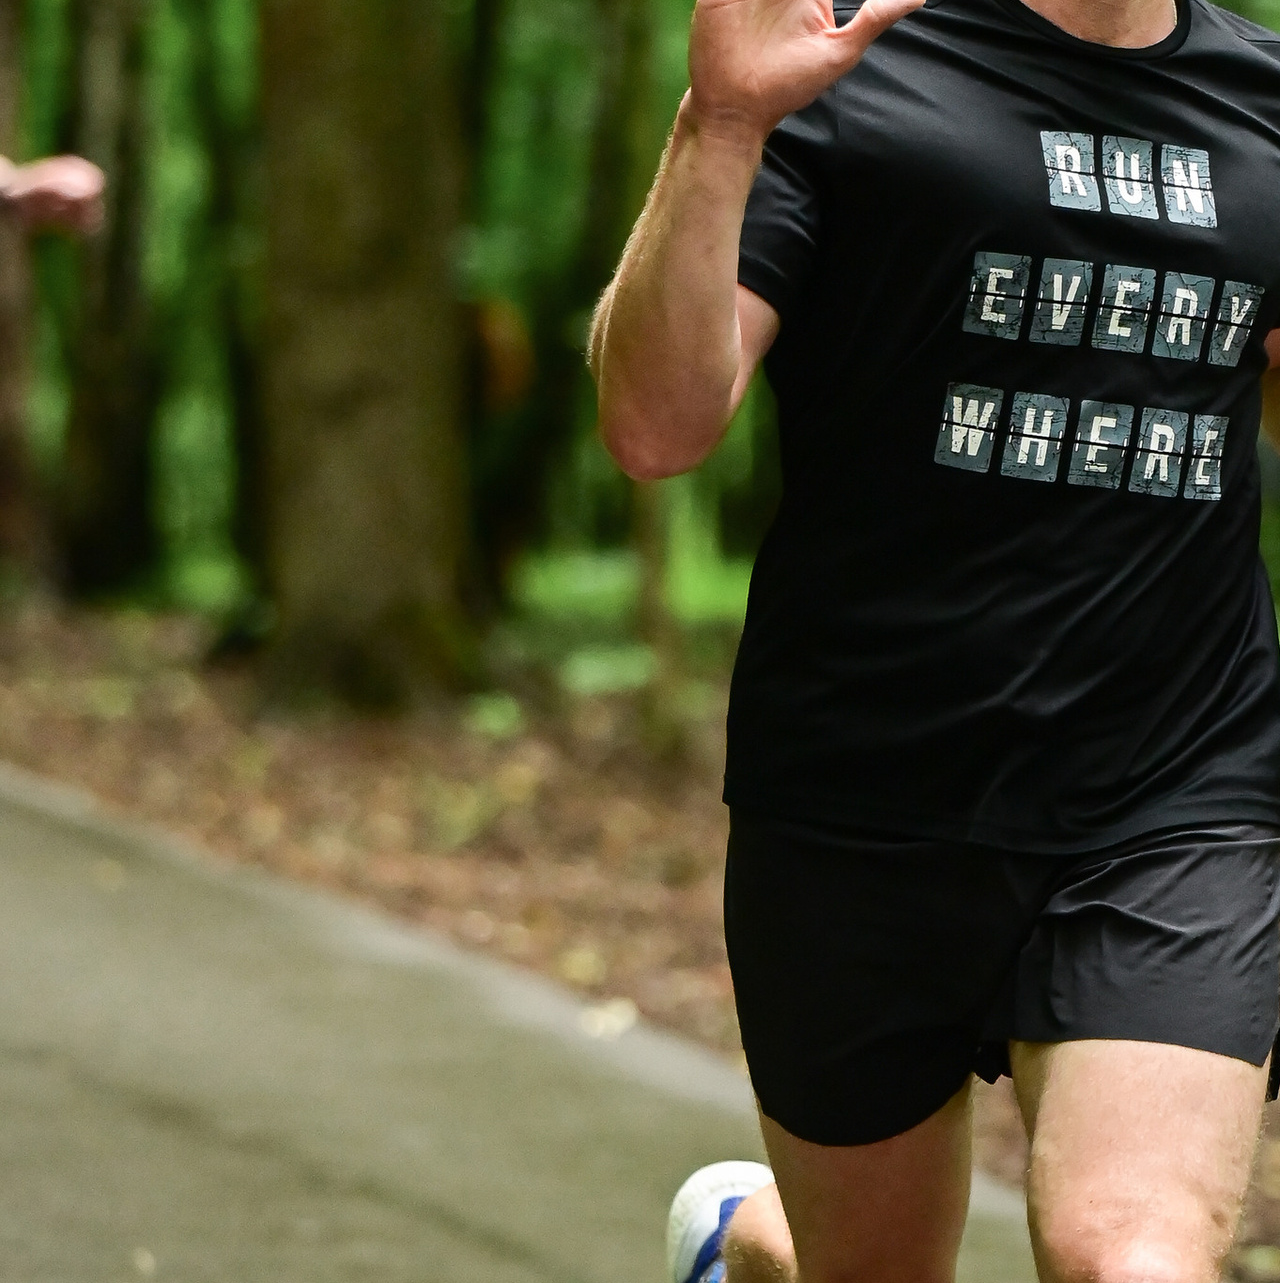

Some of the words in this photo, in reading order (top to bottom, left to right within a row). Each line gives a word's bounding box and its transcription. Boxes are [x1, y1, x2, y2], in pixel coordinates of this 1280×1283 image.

[1055, 144, 1204, 214] RUN
[980, 267, 1253, 352] EVERY
[950, 395, 1219, 486] WHERE
